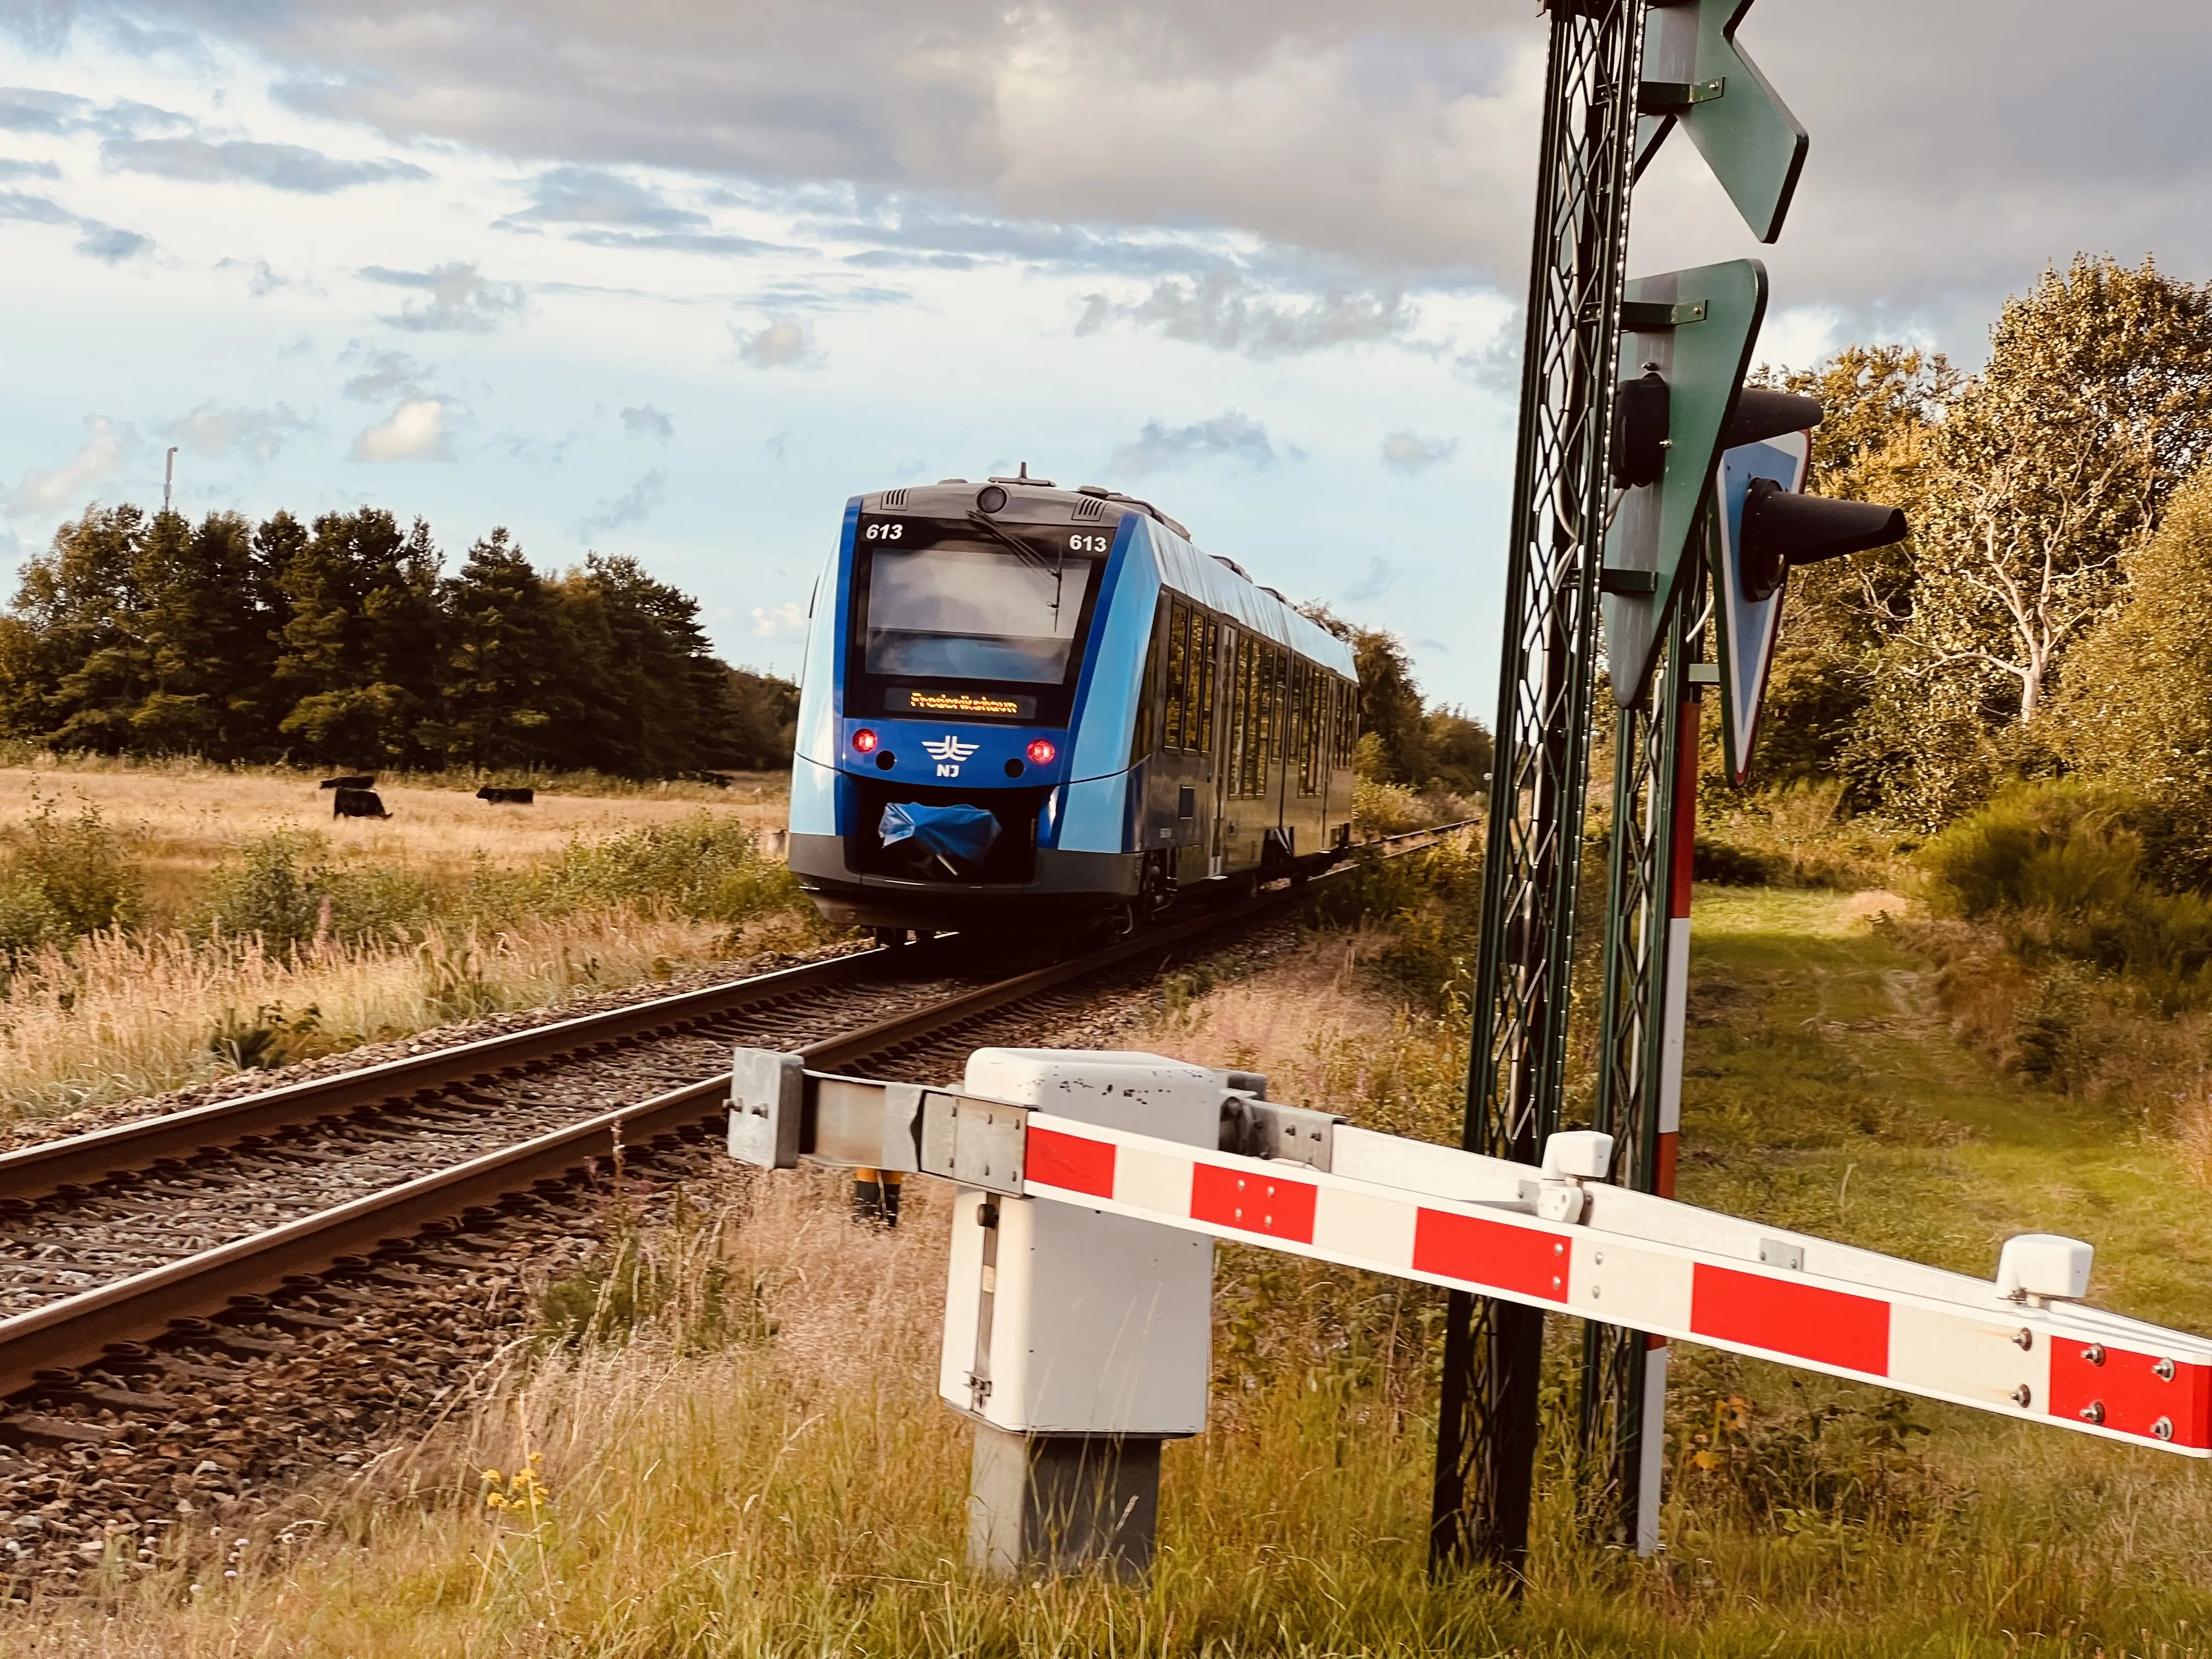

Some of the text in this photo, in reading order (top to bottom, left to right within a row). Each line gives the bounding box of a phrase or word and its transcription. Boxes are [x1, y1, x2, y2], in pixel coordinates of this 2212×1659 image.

[866, 523, 904, 540] 613
[1069, 534, 1107, 552] 613
[936, 764, 960, 777] NJ
